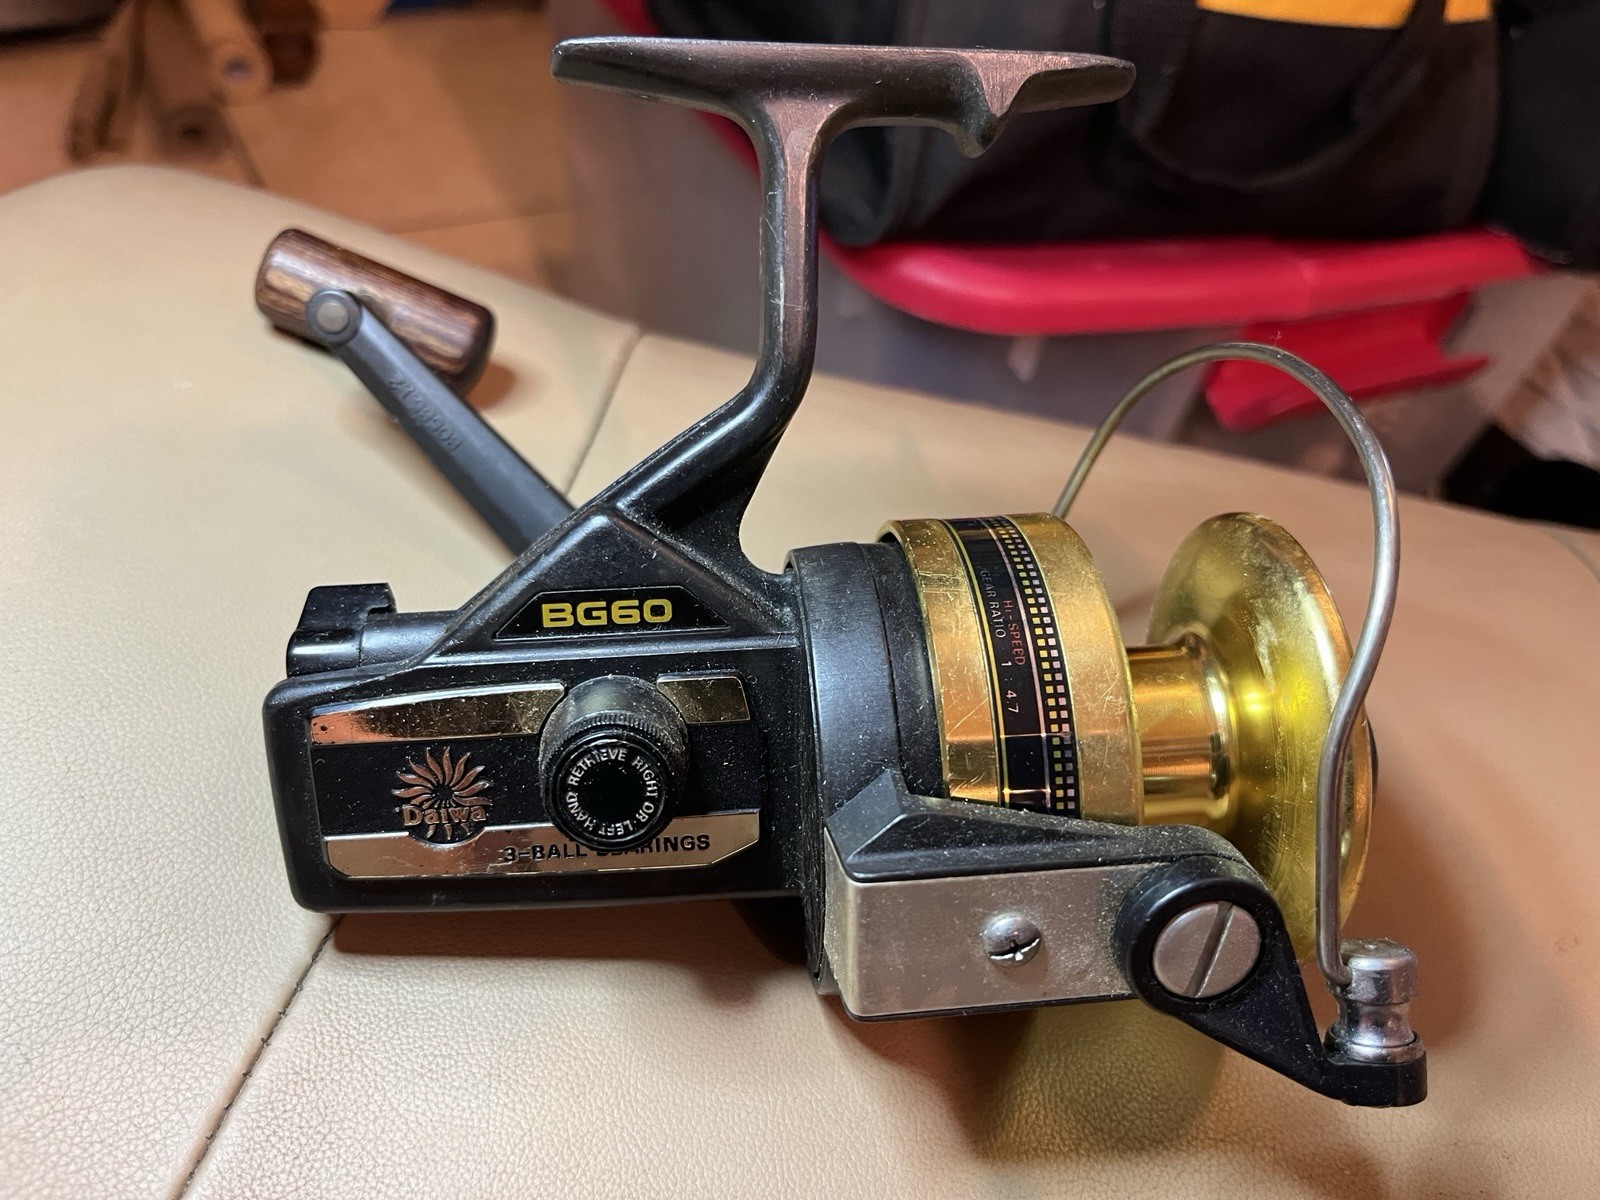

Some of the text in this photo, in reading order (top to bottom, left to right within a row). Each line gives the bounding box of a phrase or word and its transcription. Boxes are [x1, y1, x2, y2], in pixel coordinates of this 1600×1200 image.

[541, 598, 673, 628] BG60
[980, 570, 997, 598] GEAR
[989, 601, 1007, 638] RATIO
[1006, 690, 1019, 713] 4.7
[566, 748, 658, 836] RIGHT OR LEFT HAND RETRIEVE
[402, 804, 486, 826] Daiwa
[503, 833, 711, 862] 3-BALL INGS
